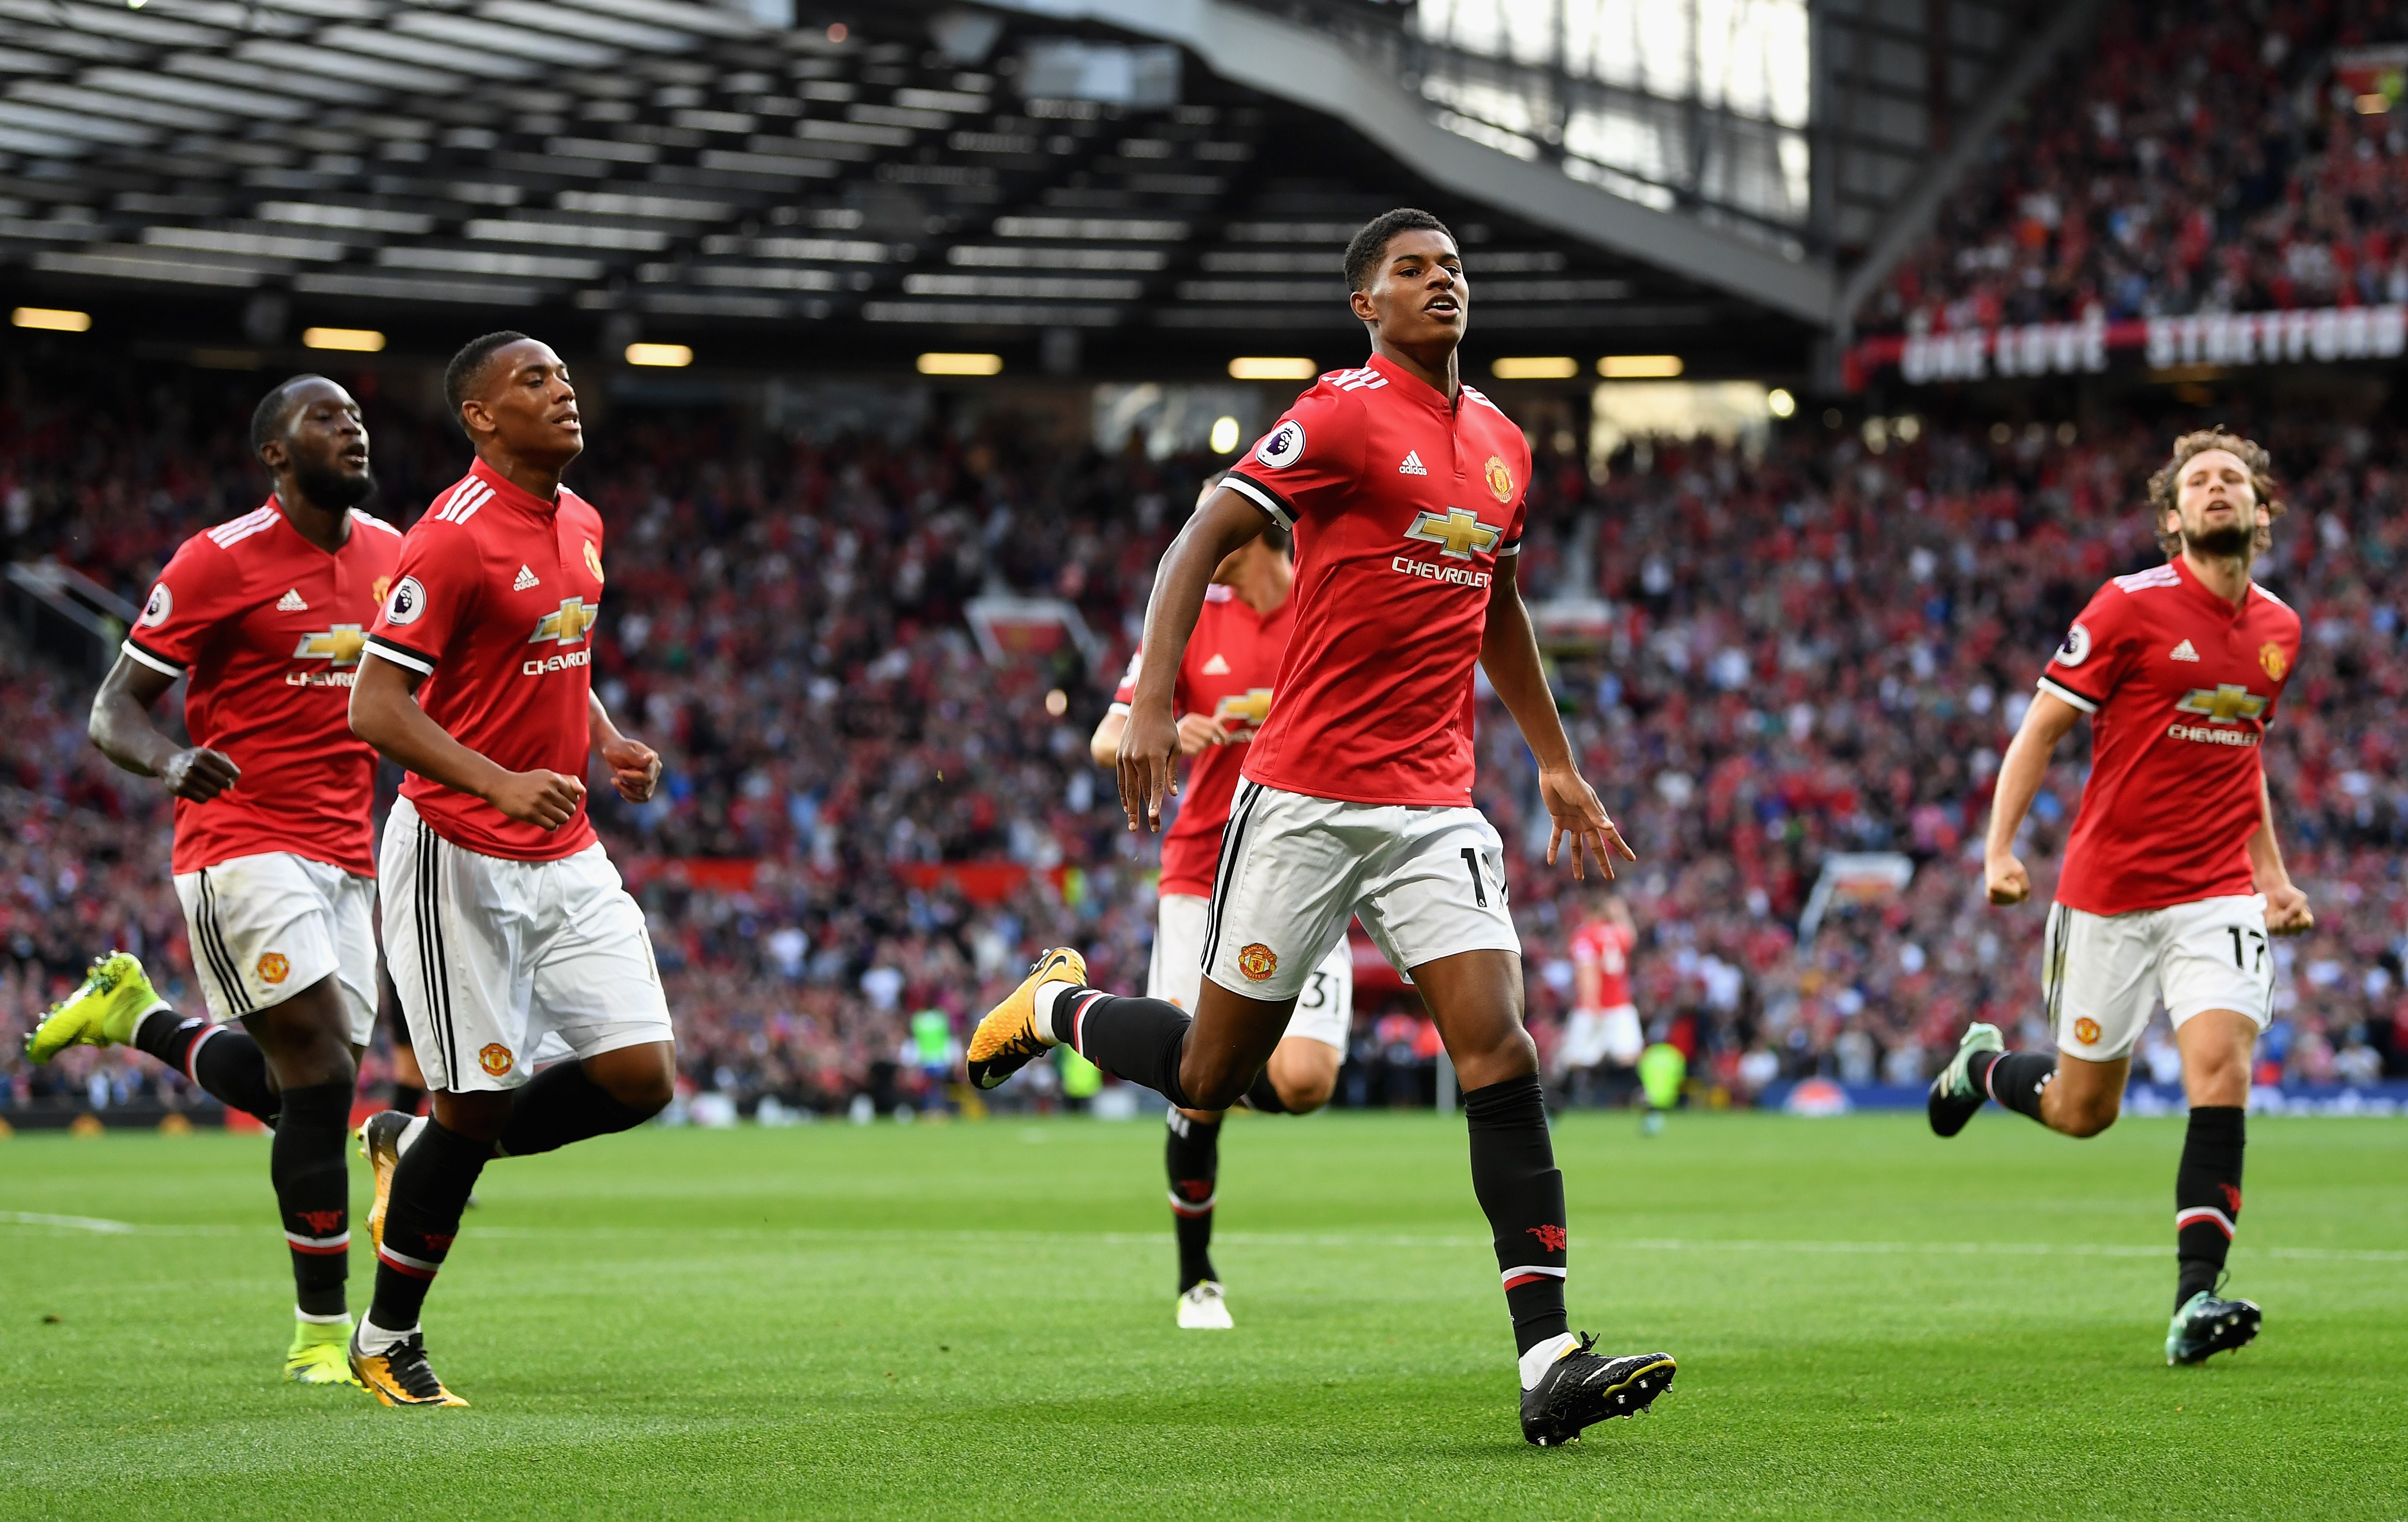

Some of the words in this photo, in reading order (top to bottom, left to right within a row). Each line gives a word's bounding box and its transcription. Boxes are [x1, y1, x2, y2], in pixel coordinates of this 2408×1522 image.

[1399, 464, 1427, 476] adidas
[1392, 556, 1489, 588] CHEVROLET
[1243, 945, 1274, 962] MANCHESTER
[1244, 968, 1265, 979] UNITED
